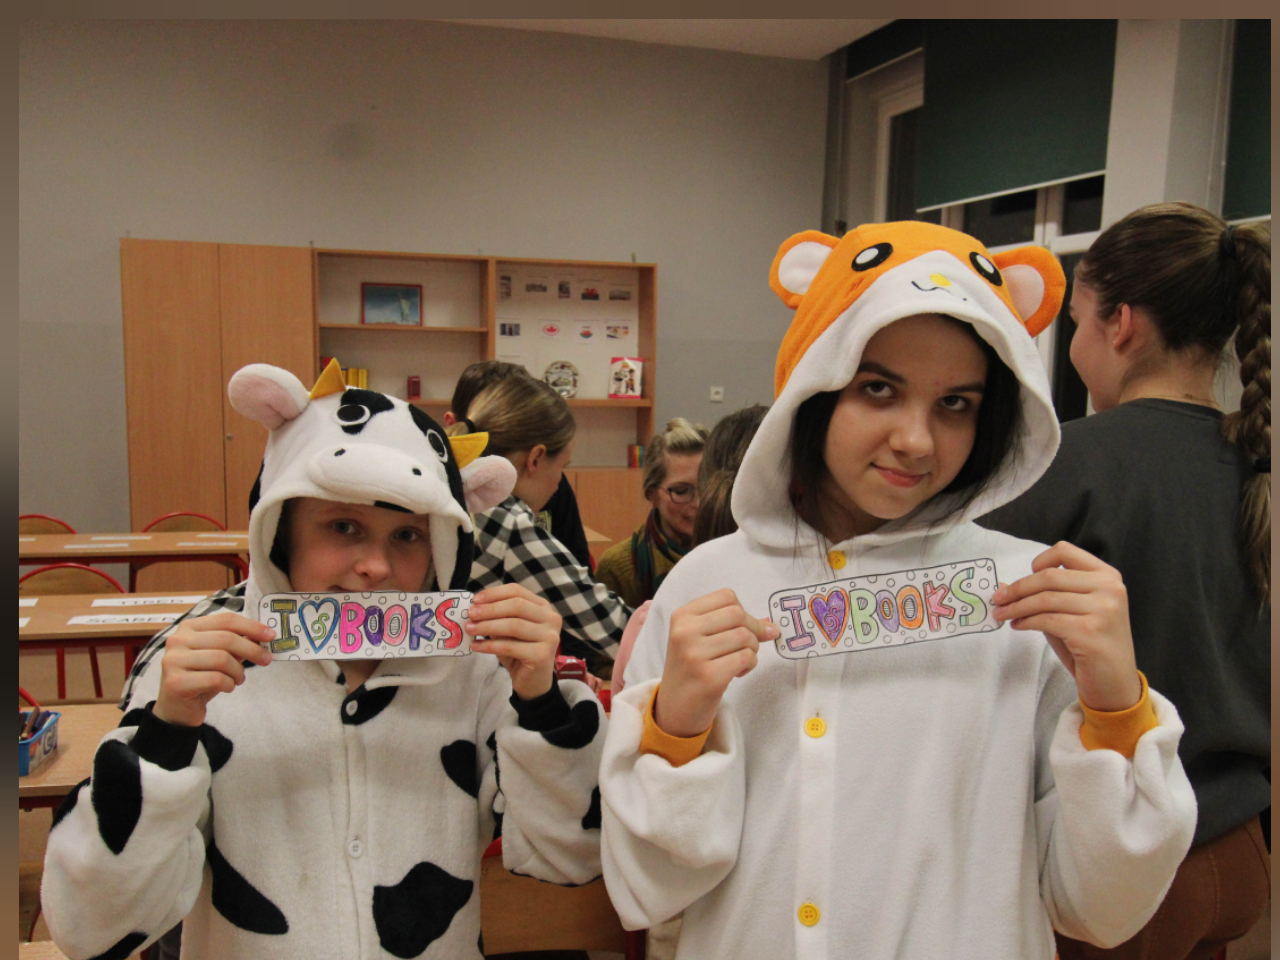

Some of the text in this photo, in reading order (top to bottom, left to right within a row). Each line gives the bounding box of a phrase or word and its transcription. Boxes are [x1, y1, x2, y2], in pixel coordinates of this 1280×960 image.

[270, 597, 463, 653] I BOOKS
[780, 567, 988, 651] I BOOKS
